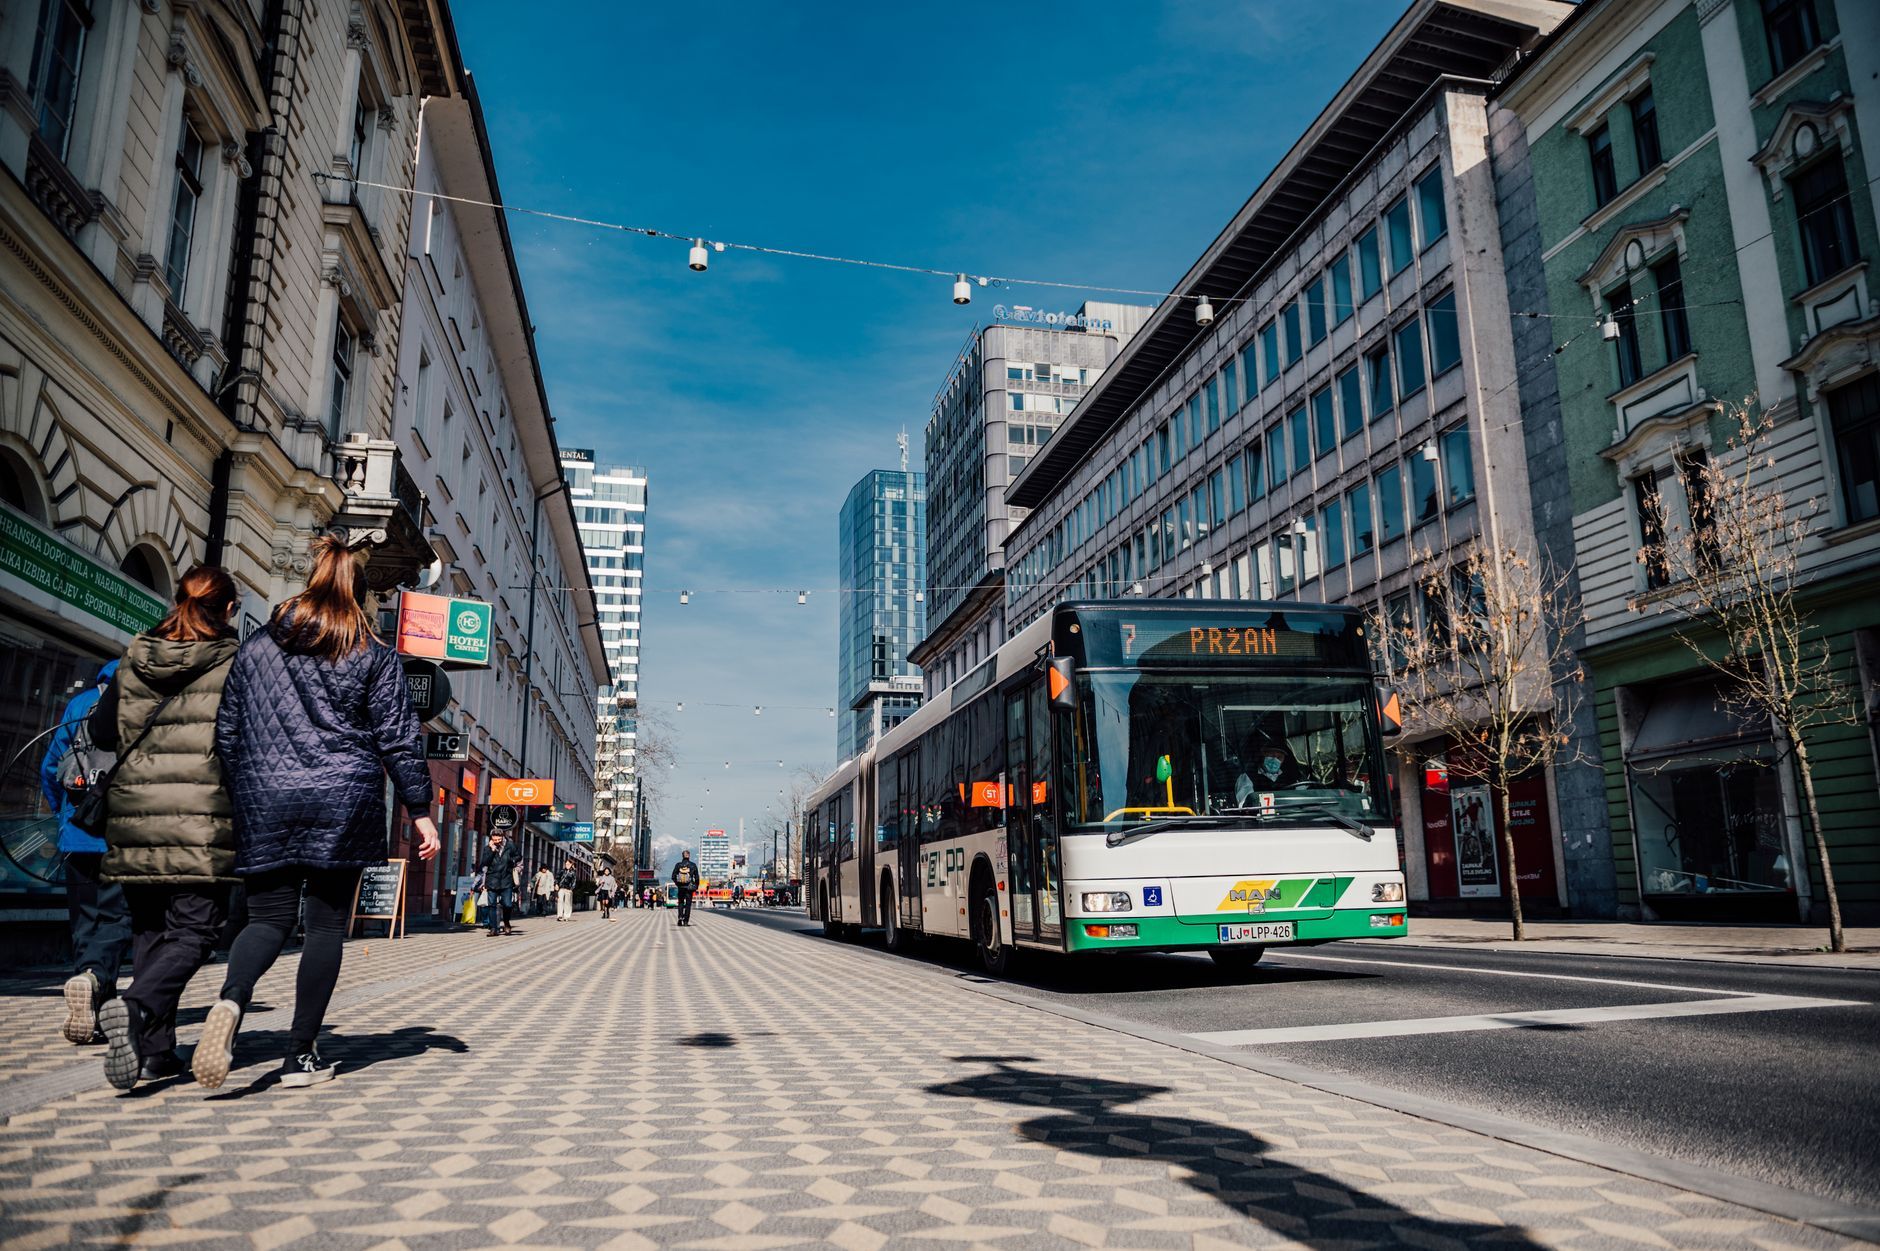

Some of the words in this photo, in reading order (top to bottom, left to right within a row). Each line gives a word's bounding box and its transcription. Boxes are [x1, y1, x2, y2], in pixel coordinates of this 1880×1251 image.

[43, 542, 88, 579] DOPOLNILA
[94, 571, 128, 601] NARAVNA
[128, 591, 162, 619] KOZMETIKA
[22, 559, 51, 587] IZBIRA
[52, 571, 79, 600] ČAJEV
[84, 591, 116, 619] ŠPORTNA
[449, 635, 486, 647] HOTEL
[1122, 624, 1136, 656] 7
[1190, 626, 1277, 654] PRŽAN
[410, 691, 427, 703] AFE
[511, 787, 534, 797] T2
[1263, 797, 1271, 814] 7
[1229, 888, 1282, 902] MAN
[1229, 927, 1243, 940] LJ
